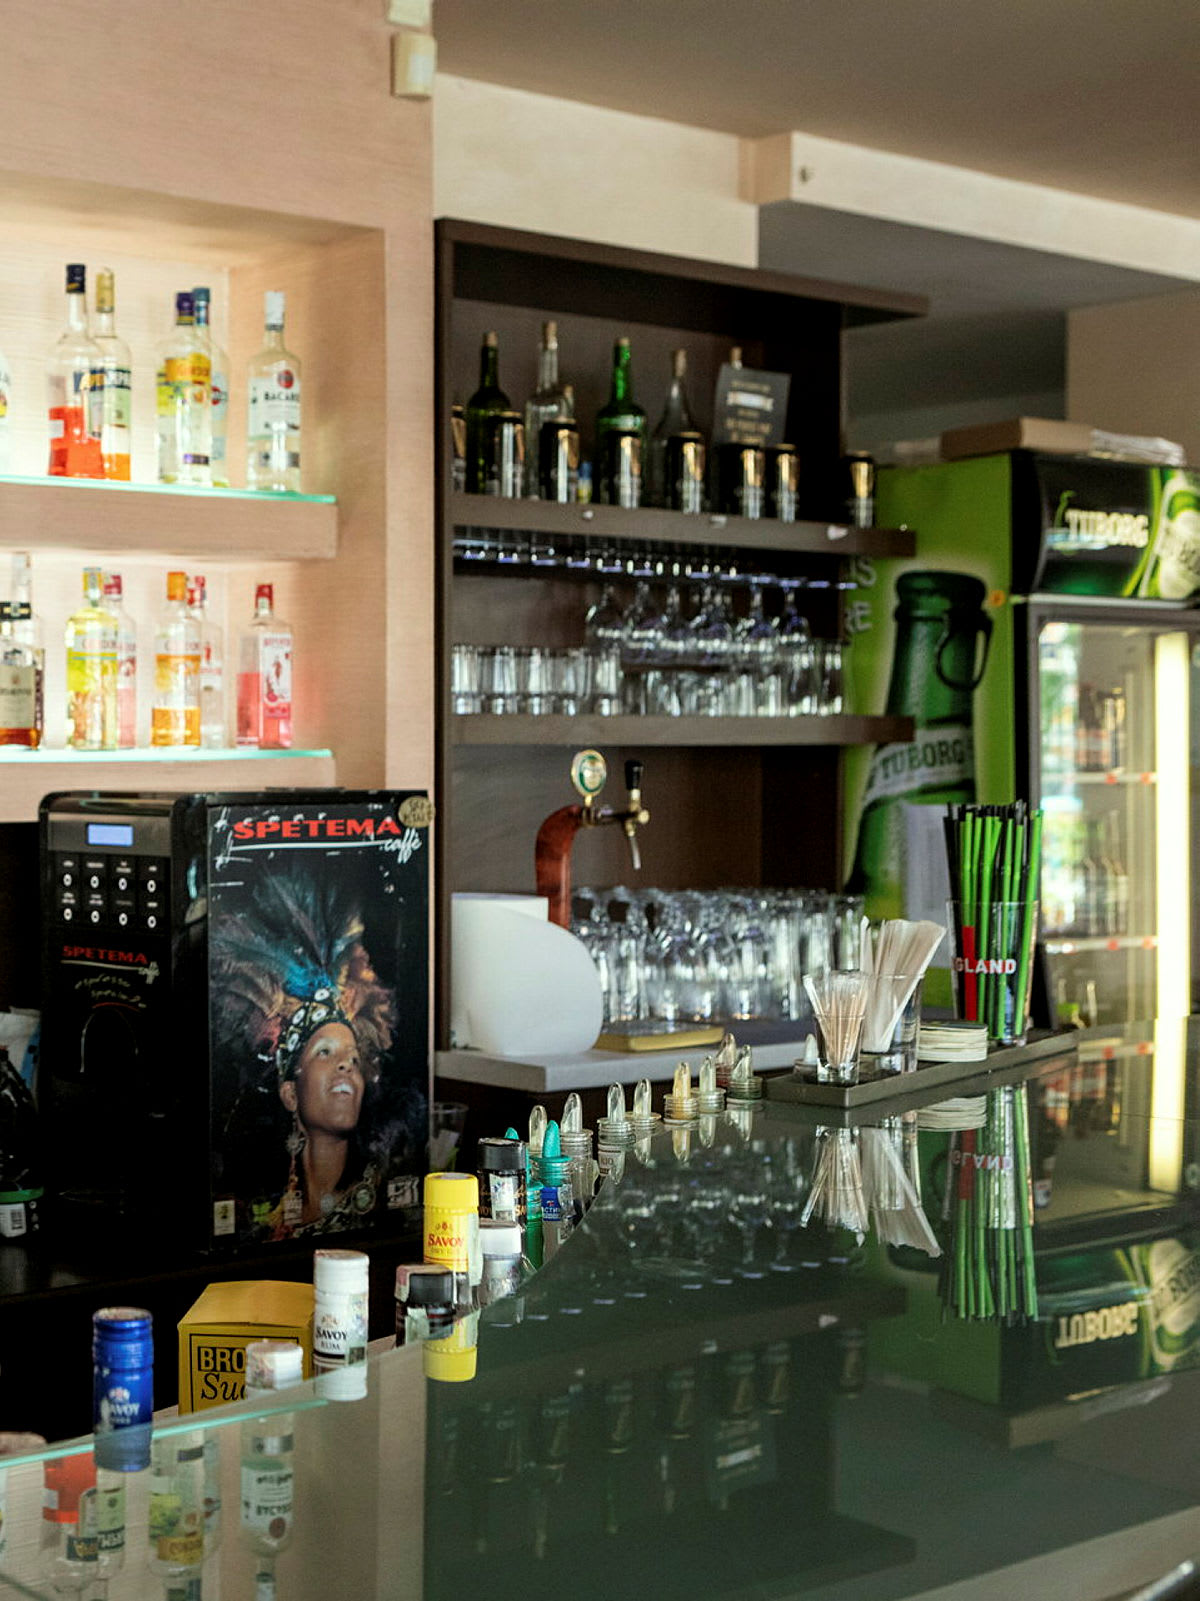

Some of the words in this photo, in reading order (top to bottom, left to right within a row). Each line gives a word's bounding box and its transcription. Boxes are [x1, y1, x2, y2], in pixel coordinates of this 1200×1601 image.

[1064, 508, 1149, 548] TUBORG
[232, 818, 402, 840] SPETEMA
[62, 945, 149, 965] SPETEMA
[427, 1232, 464, 1248] SAVOY
[315, 1325, 347, 1341] SAVOY
[200, 1348, 246, 1373] BRO
[106, 1401, 141, 1417] AVOY
